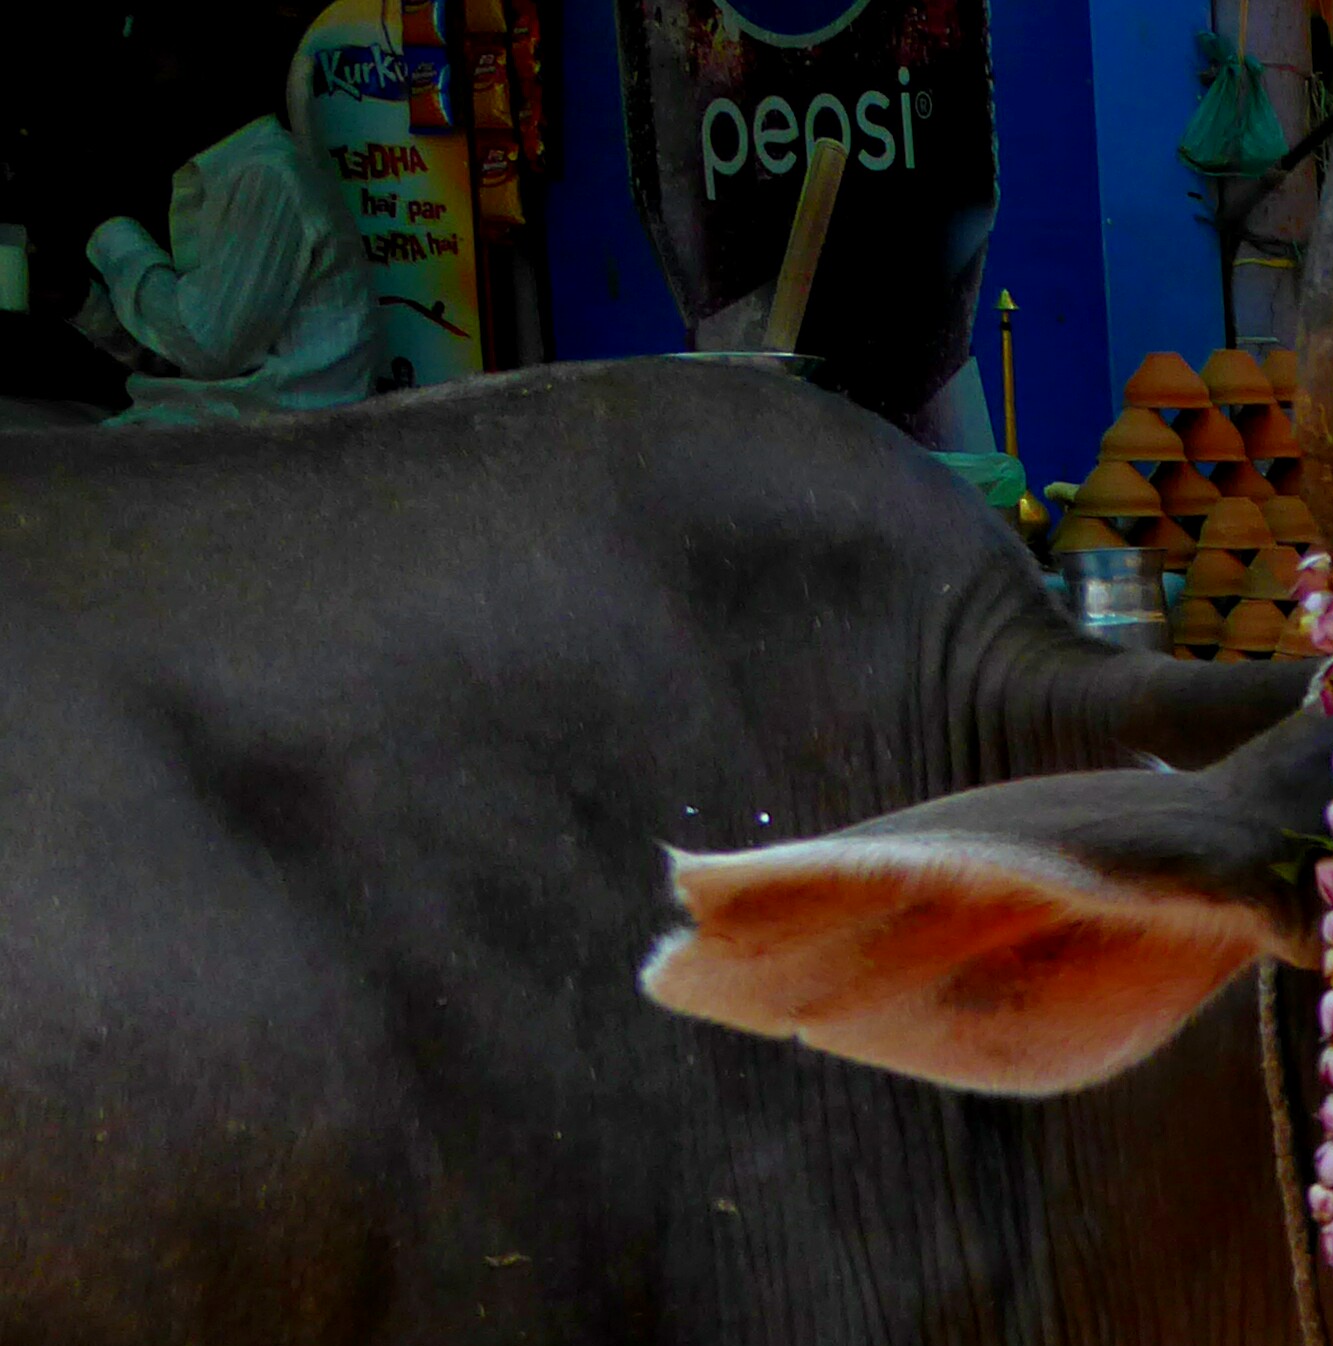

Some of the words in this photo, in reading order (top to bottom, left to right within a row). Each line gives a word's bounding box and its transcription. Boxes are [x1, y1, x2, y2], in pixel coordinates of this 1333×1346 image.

[317, 43, 409, 100] Kurku
[361, 187, 397, 218] hai
[408, 200, 447, 223] par
[426, 231, 459, 257] hai
